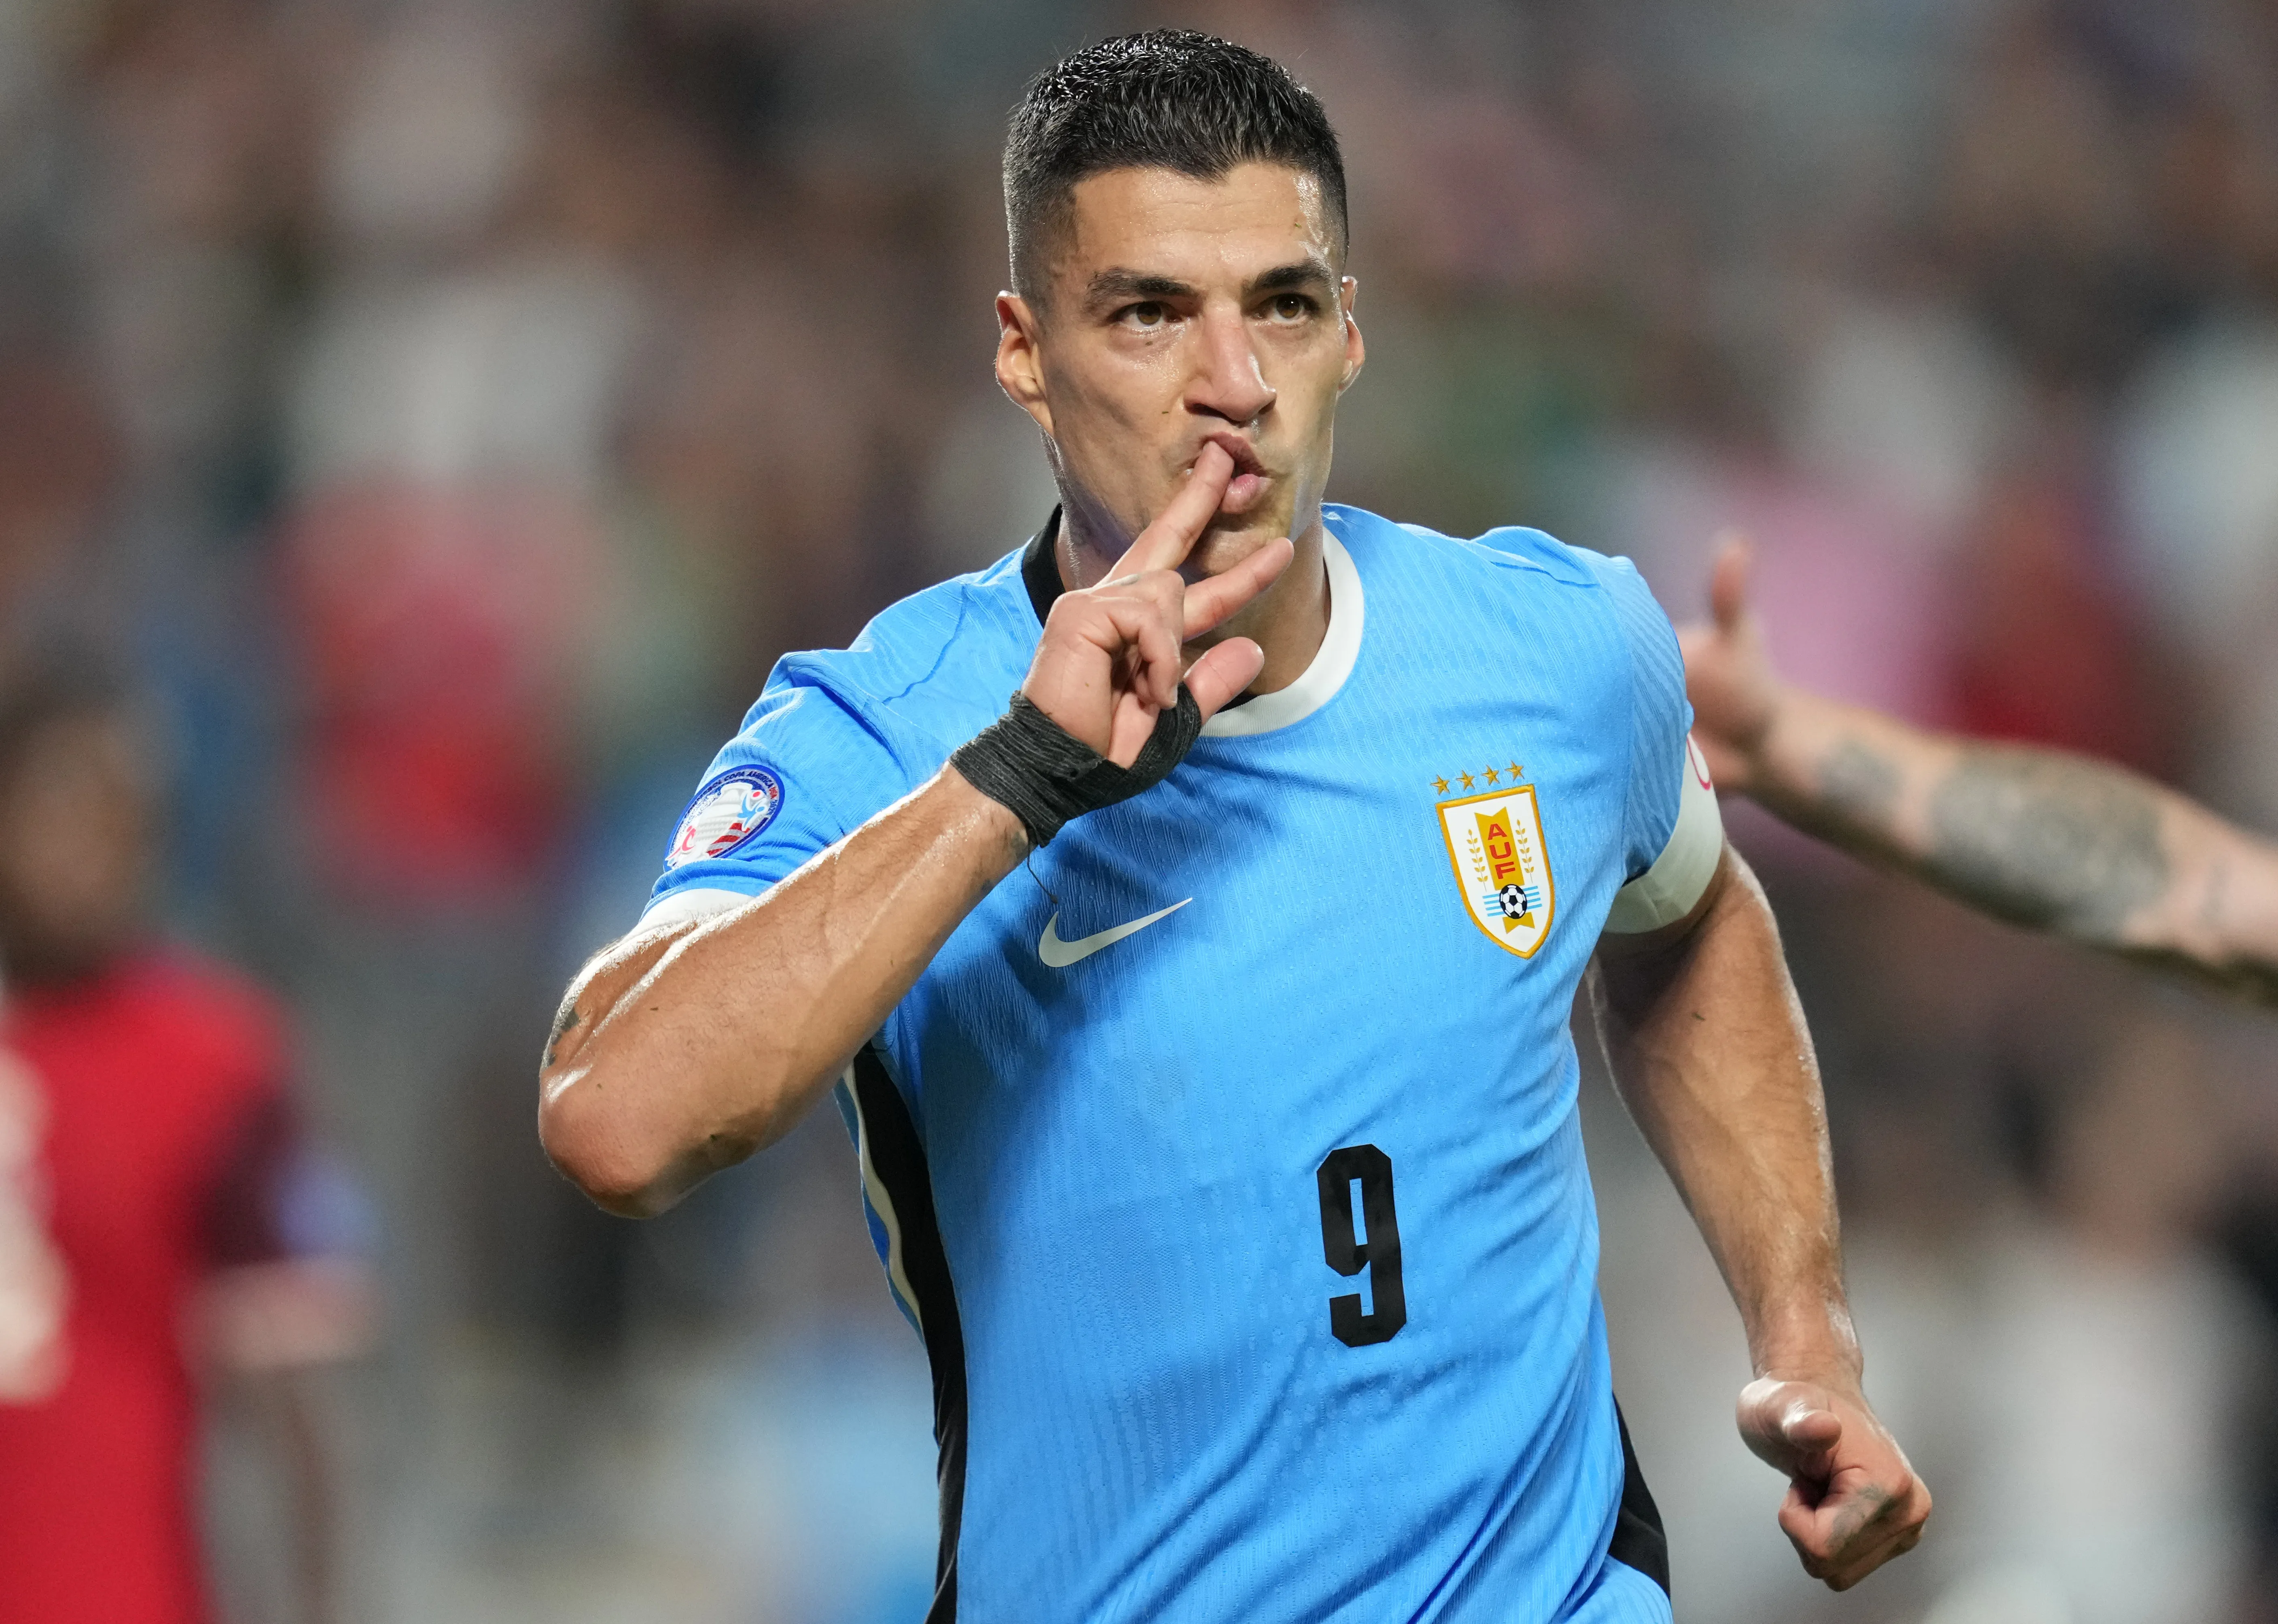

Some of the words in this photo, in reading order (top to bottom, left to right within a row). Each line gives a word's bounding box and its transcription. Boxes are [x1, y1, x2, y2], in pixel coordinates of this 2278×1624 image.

[724, 771, 745, 782] COPA
[1488, 823, 1515, 879] AUF
[1317, 1144, 1407, 1348] 9
